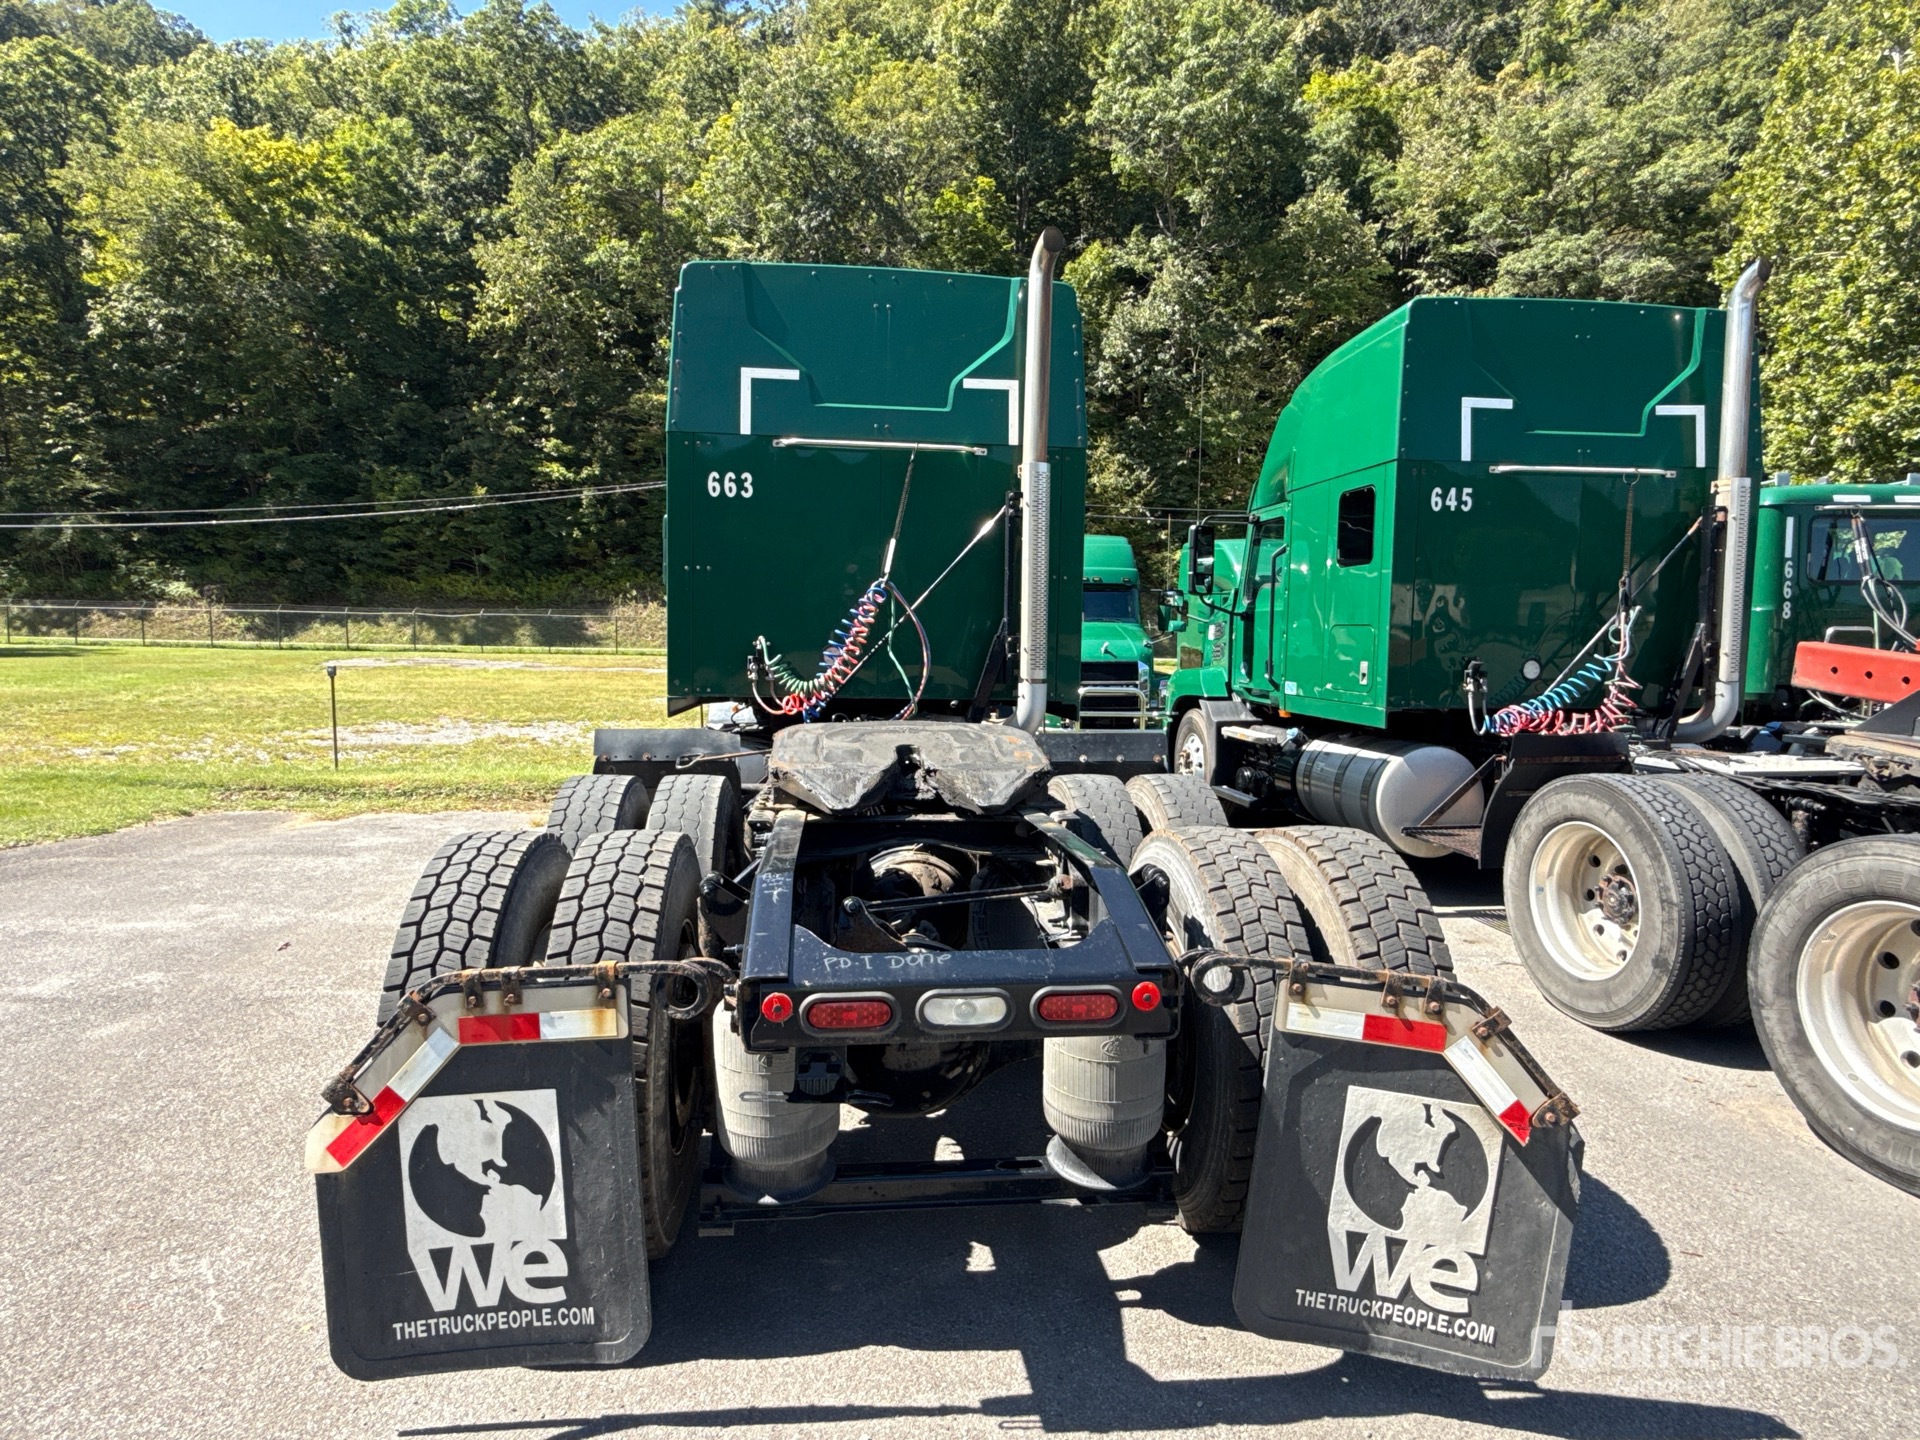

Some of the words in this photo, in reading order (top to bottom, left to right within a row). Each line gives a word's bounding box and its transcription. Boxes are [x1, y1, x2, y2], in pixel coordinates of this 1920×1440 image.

[708, 471, 754, 498] 663
[1431, 487, 1473, 512] 645
[1782, 560, 1793, 620] 668
[392, 1306, 595, 1341] THETRUCKPEOPLE.COM
[1296, 1289, 1496, 1344] THETRUCKPEOPLE.COM
